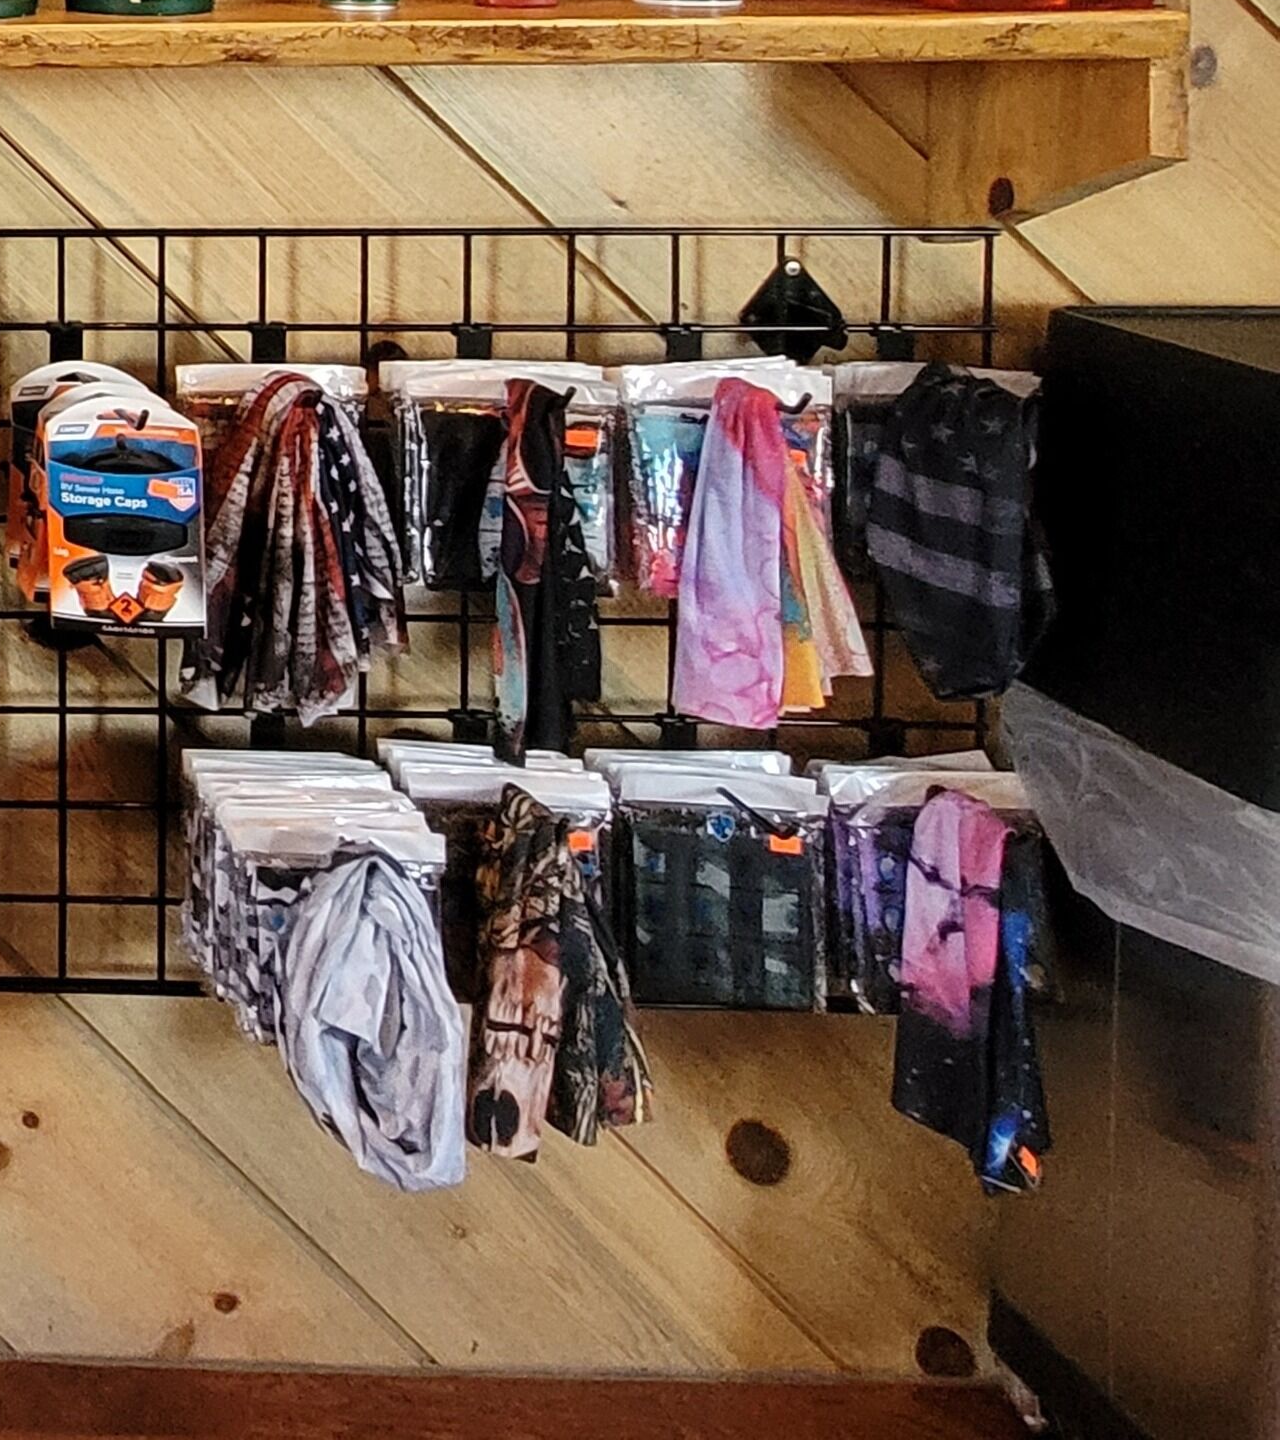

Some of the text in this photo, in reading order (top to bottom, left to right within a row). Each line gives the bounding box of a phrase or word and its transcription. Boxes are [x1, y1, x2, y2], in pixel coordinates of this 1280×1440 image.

[61, 483, 125, 495] RV Sewer Hose
[61, 492, 148, 510] Storage Caps
